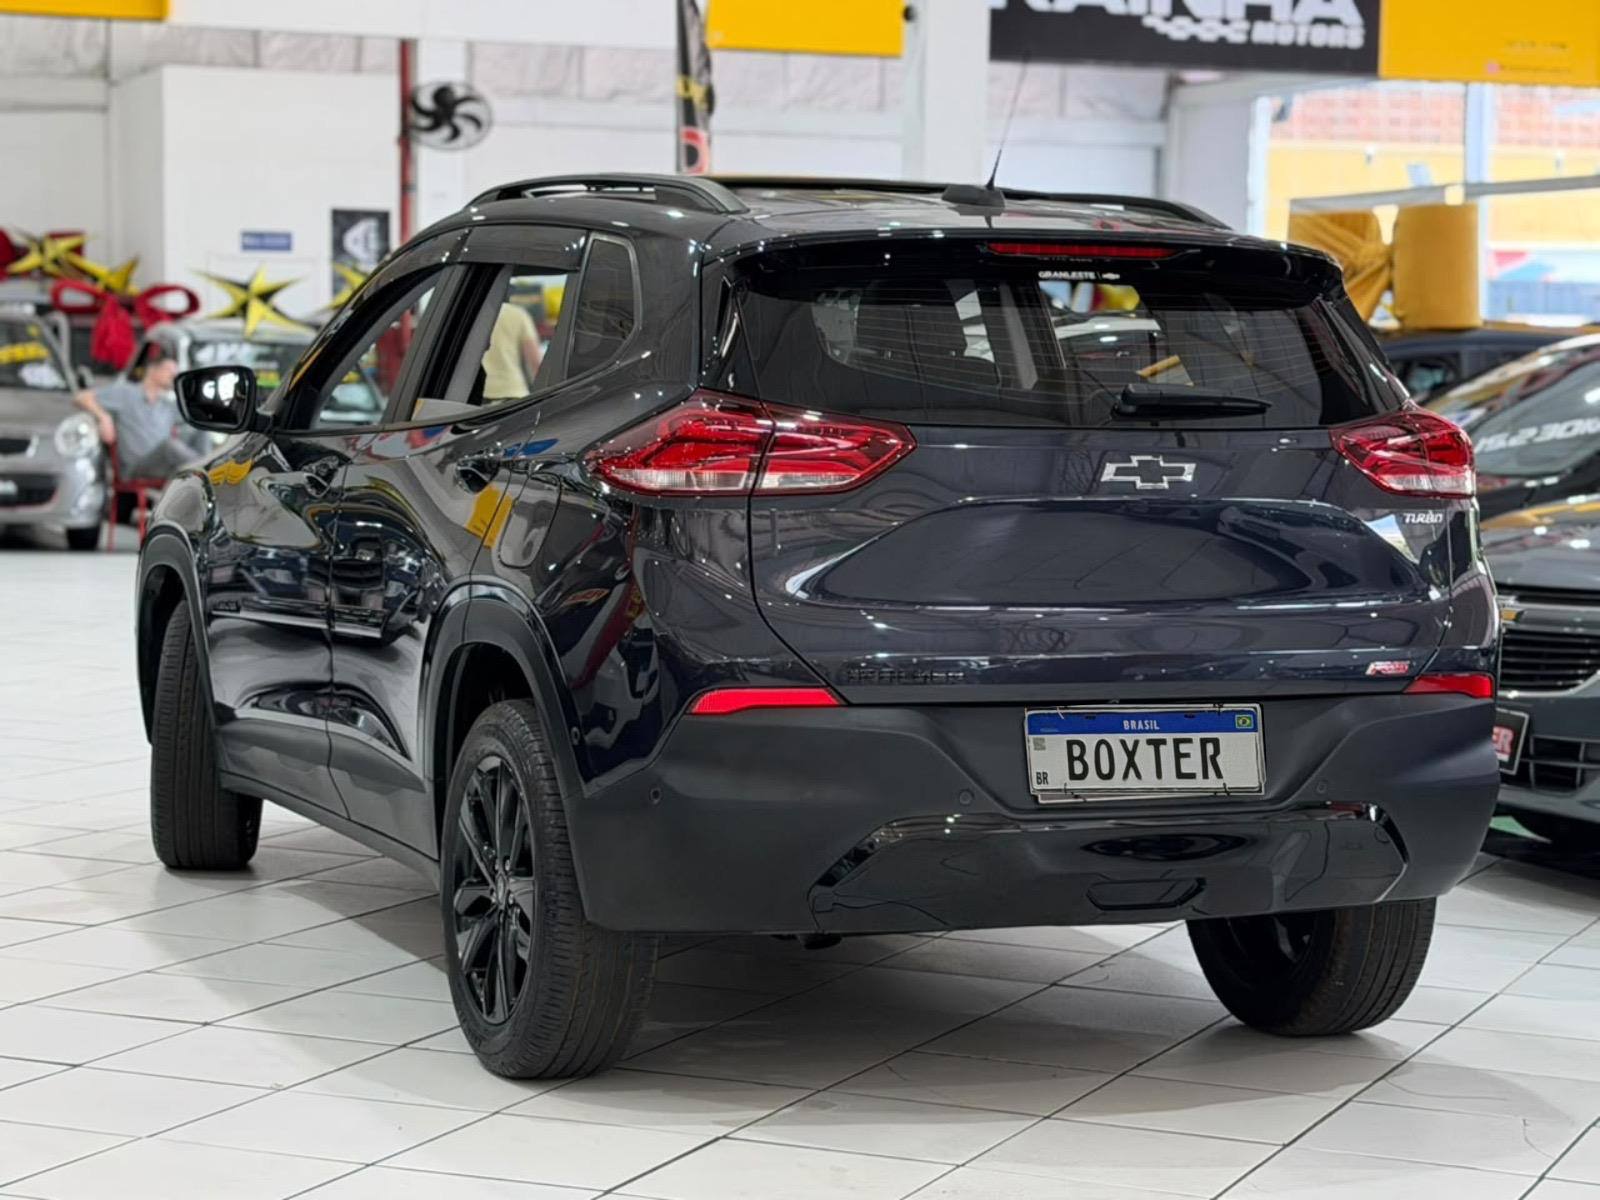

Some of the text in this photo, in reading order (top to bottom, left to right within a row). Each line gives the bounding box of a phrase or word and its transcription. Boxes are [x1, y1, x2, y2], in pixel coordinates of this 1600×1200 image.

[1251, 20, 1365, 50] MOTORS
[1402, 512, 1444, 524] TURBO
[1122, 719, 1161, 731] BRASIL
[1065, 736, 1224, 781] BOXTER
[1036, 771, 1049, 786] BR
